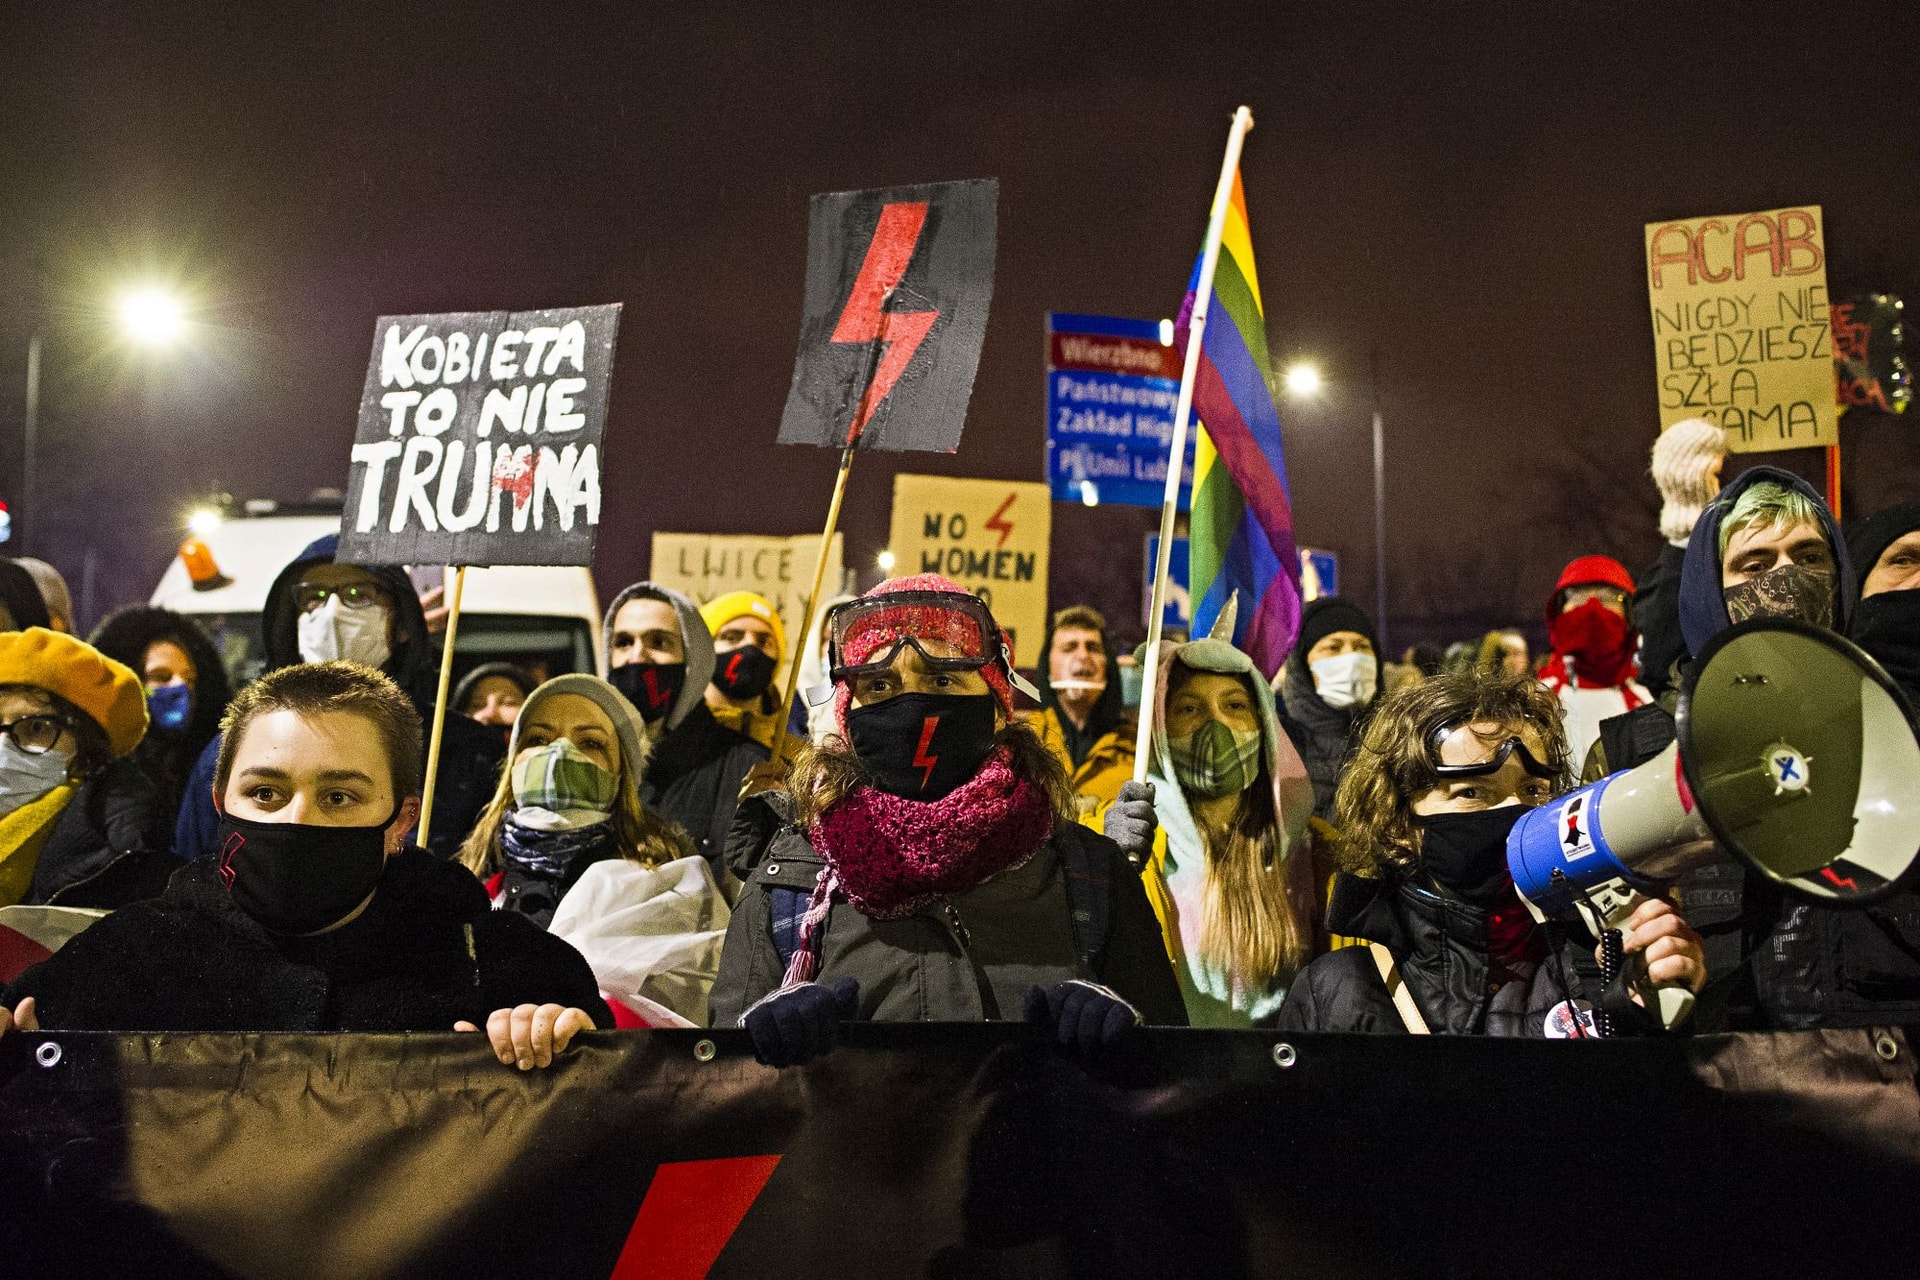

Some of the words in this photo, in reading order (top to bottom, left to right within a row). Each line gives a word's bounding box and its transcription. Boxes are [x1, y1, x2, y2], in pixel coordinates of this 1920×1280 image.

[1651, 210, 1823, 289] ACAB
[1655, 292, 1756, 335] NIGDY
[1778, 285, 1829, 323] NIE
[381, 320, 585, 388] KOBIETA
[1667, 323, 1831, 373] BĘDZIESZ
[380, 388, 458, 437] TO
[477, 378, 586, 438] NIE
[1663, 368, 1758, 410] SZŁA
[351, 436, 601, 533] TRUMNA
[923, 512, 967, 539] NO
[679, 547, 794, 582] LWICE
[920, 547, 1035, 581] WOMEN
